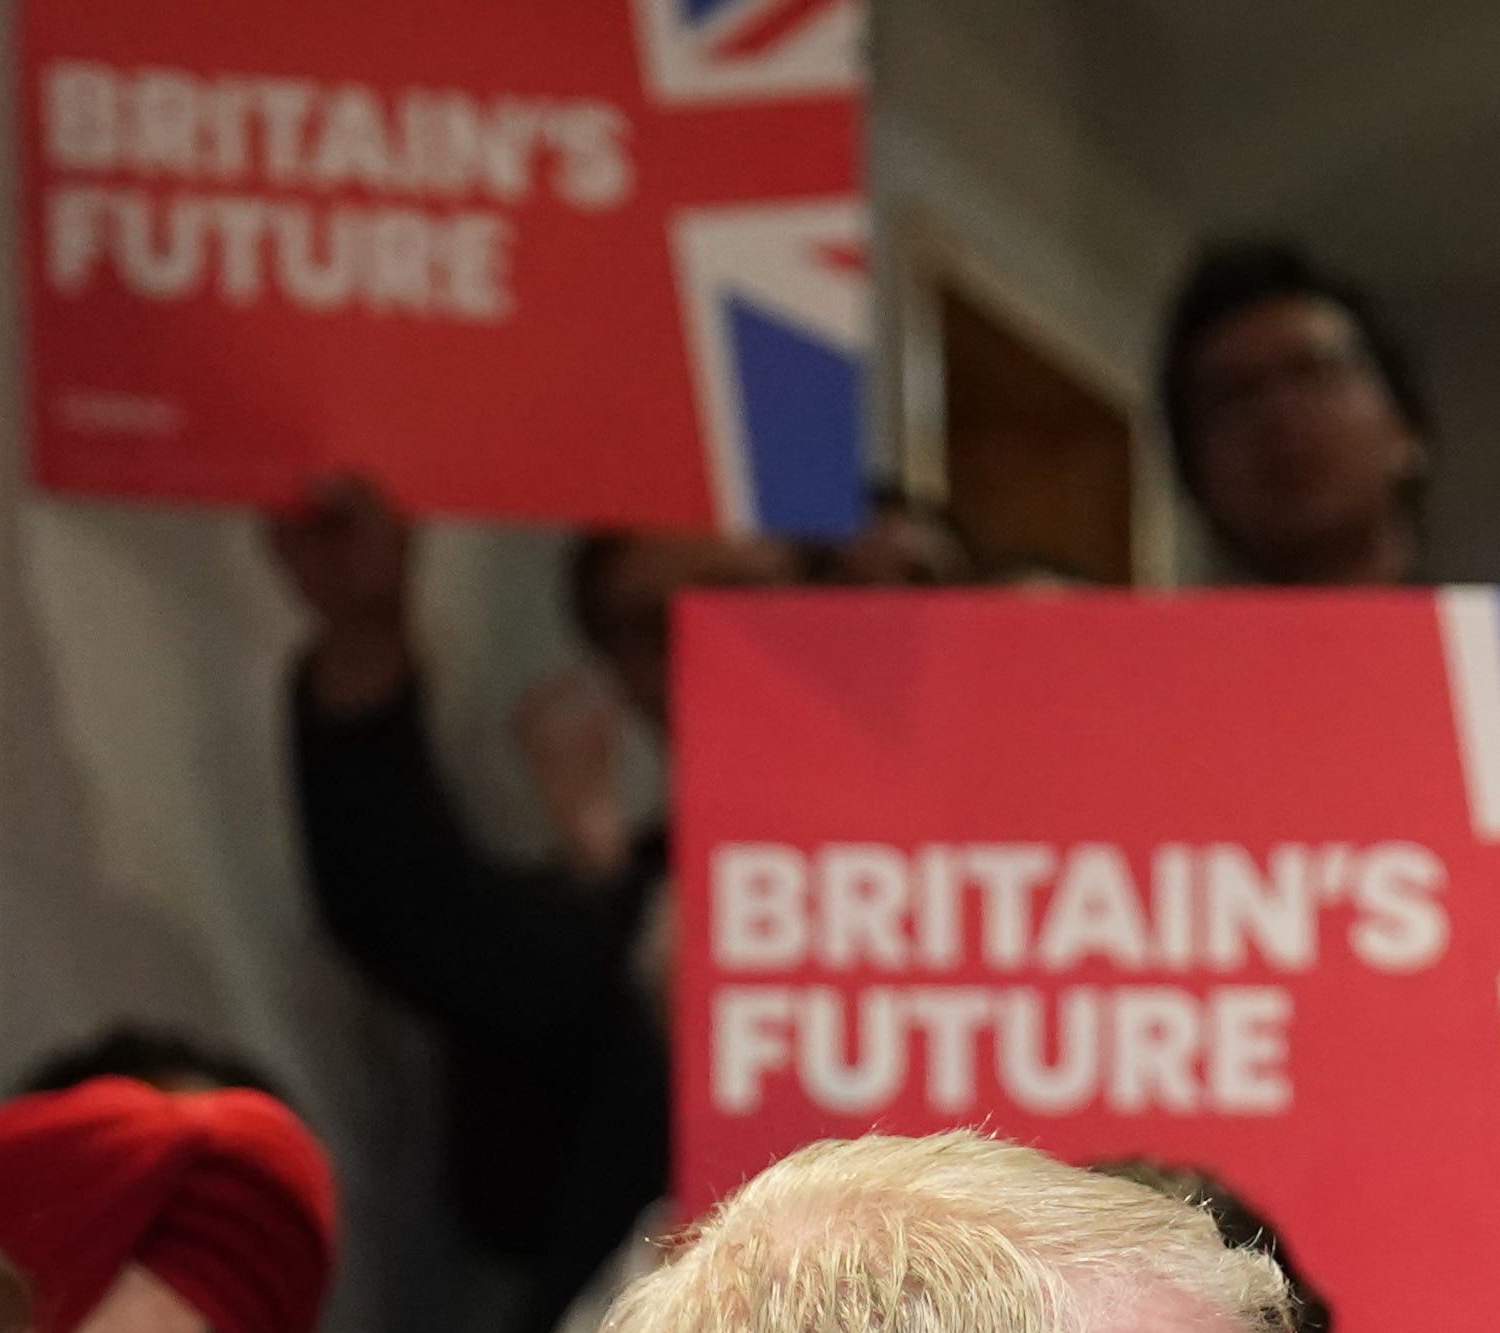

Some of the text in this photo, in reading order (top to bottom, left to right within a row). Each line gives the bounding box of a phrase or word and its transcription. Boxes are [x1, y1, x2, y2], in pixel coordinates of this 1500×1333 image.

[45, 63, 633, 211] BRITAIN'S
[49, 186, 512, 322] FUTURE
[713, 842, 1450, 971] BRITAIN'S
[713, 986, 1293, 1114] FUTURE
